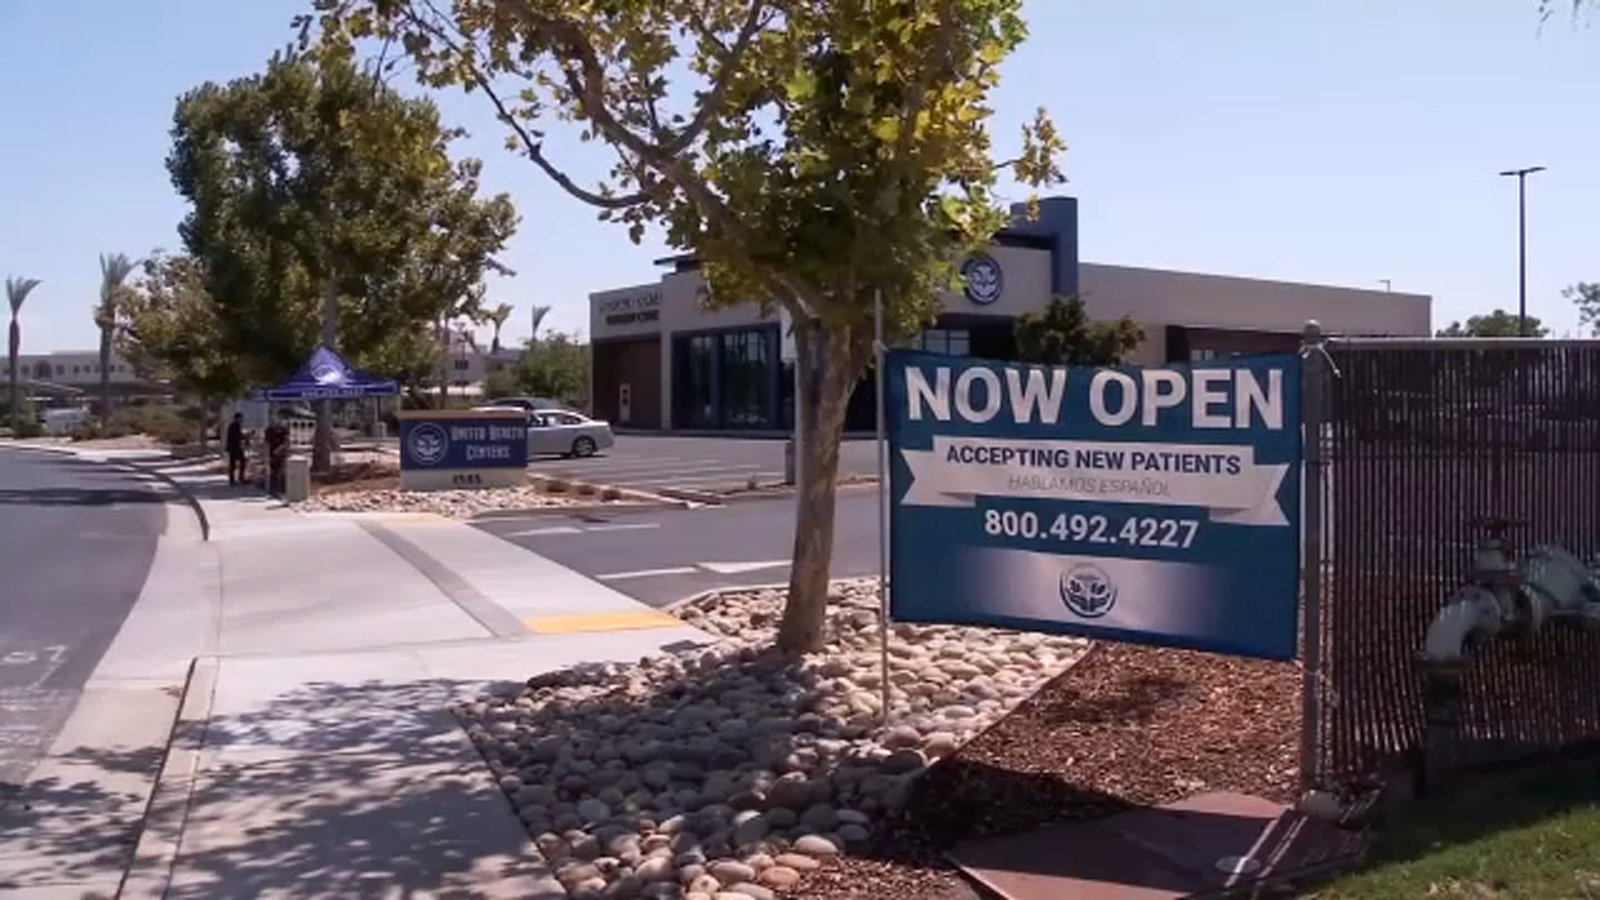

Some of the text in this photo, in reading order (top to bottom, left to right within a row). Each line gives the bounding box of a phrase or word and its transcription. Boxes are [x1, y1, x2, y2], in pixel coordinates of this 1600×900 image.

[906, 366, 1283, 430] NOW OPEN
[946, 445, 1241, 476] ACCEPTING NEW PATIENTS
[1008, 473, 1171, 498] HABLAMOS ESPAÑOL
[984, 509, 1199, 548] 800.492.4227
